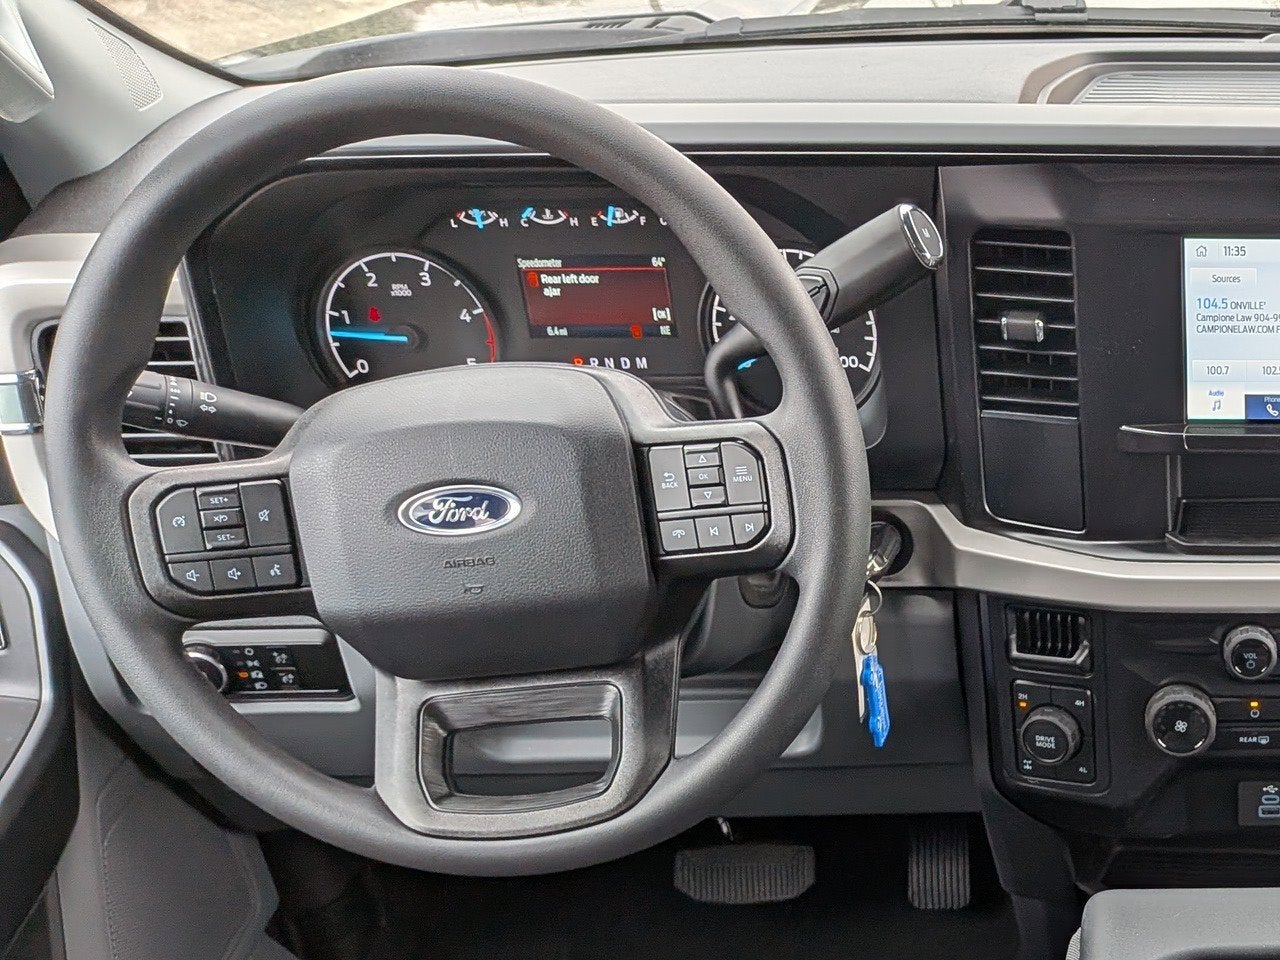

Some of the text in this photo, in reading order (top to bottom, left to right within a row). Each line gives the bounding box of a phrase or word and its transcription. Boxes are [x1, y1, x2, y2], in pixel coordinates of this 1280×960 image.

[450, 218, 508, 228] L H
[520, 217, 579, 227] C H
[591, 217, 647, 227] E F
[1223, 246, 1246, 257] 11:35
[517, 258, 562, 268] Speedometer
[365, 273, 379, 287] 2
[418, 272, 432, 287] 3
[540, 273, 600, 284] Rear left door
[1212, 275, 1241, 283] Sources
[543, 287, 561, 297] ajar
[1196, 297, 1228, 310] 104.5
[341, 309, 351, 324] 1
[459, 308, 472, 323] 4
[1196, 313, 1235, 323] Campione
[1236, 314, 1252, 322] Law
[1196, 325, 1275, 334] CAMPIONELAW.COM
[356, 359, 369, 374] 0
[589, 357, 599, 368] R
[604, 357, 615, 369] N
[621, 356, 631, 369] D
[636, 356, 648, 369] M
[1206, 366, 1229, 375] 100.7
[428, 495, 490, 524] Ford
[443, 557, 495, 569] AIRBAG
[1036, 741, 1055, 749] MODE
